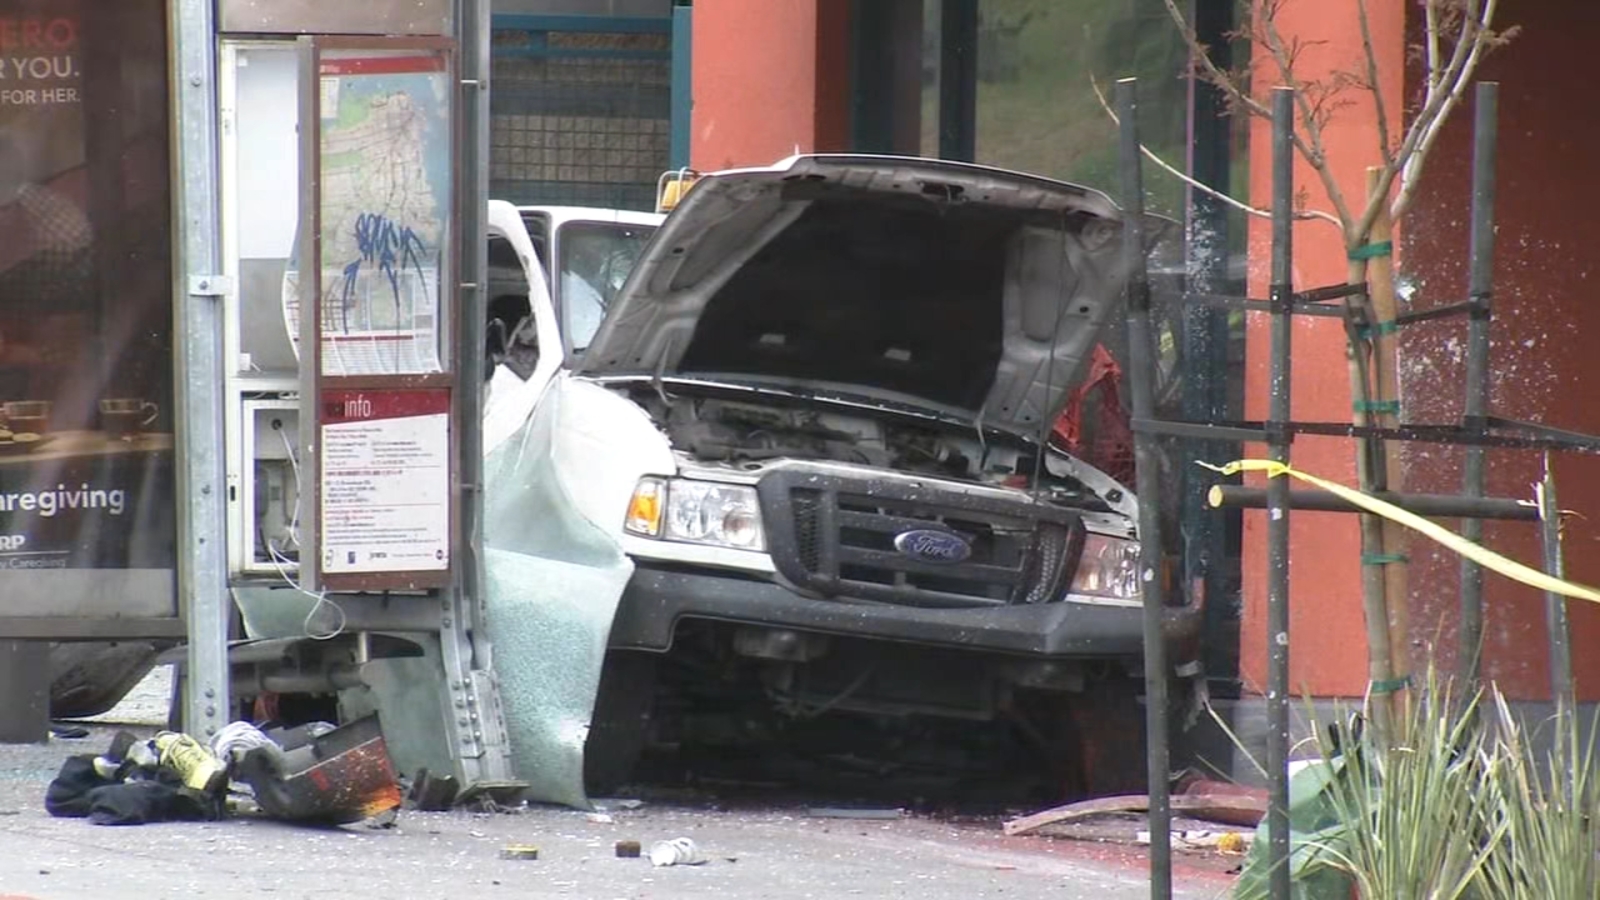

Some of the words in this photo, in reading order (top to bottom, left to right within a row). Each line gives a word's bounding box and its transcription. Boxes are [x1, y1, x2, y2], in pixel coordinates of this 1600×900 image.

[12, 55, 80, 79] YOU.
[1, 89, 36, 105] FOR
[42, 87, 81, 103] HER.
[344, 394, 371, 418] info
[0, 483, 125, 517] regiving
